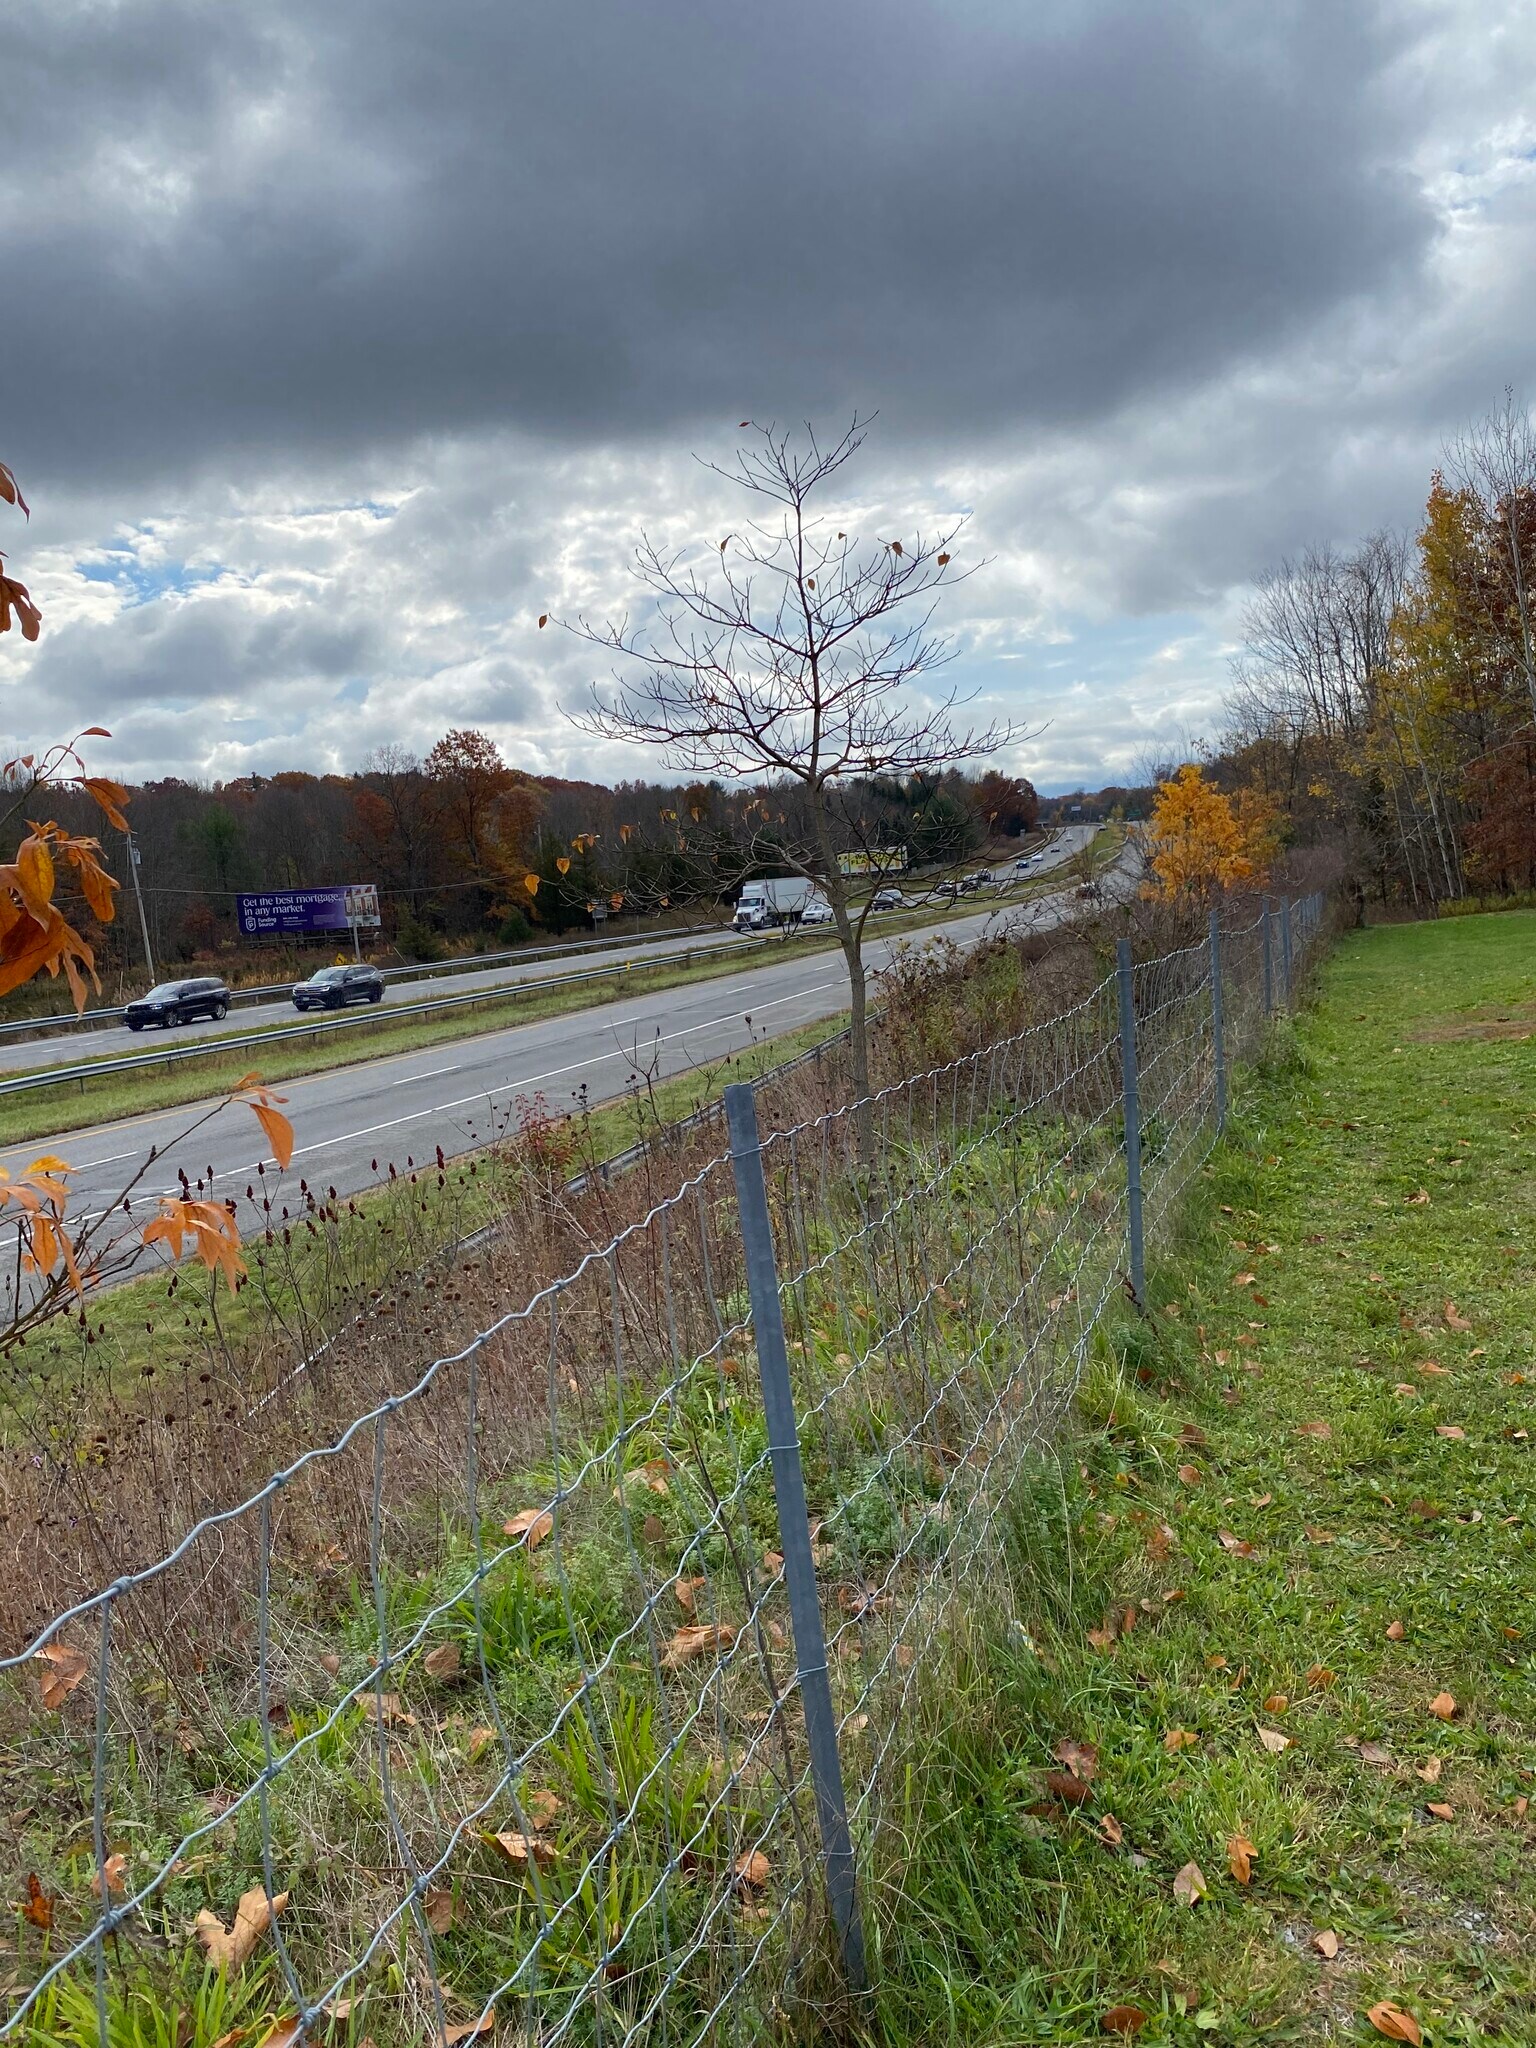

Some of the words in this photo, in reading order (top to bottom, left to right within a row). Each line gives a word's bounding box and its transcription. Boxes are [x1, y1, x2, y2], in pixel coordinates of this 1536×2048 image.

[243, 898, 257, 907] Get
[259, 897, 273, 906] the
[275, 896, 294, 905] best
[244, 907, 253, 916] in
[255, 907, 270, 916] any
